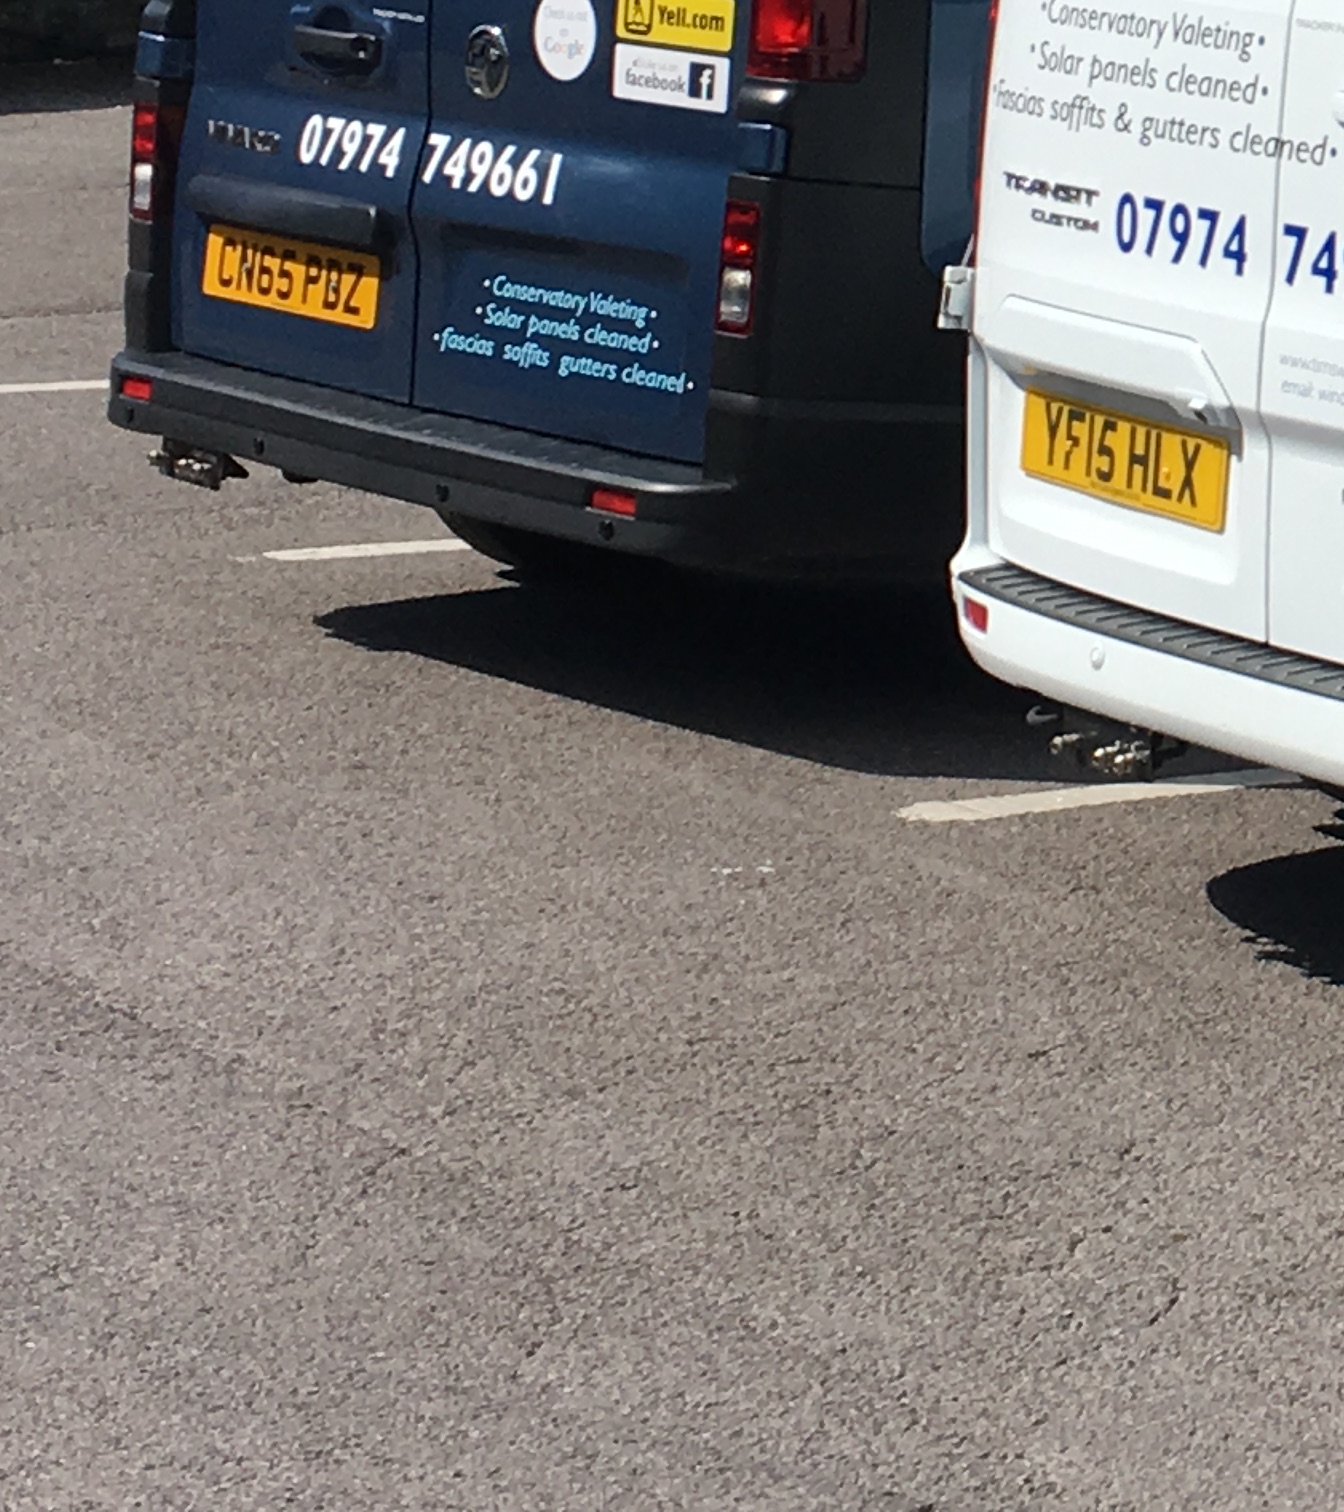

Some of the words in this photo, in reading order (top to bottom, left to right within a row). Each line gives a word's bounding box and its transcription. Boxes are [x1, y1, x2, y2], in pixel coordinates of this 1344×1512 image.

[656, 4, 726, 33] Yell.com
[1172, 12, 1256, 63] Valeting
[625, 68, 686, 93] facebook
[1037, 40, 1084, 77] Solar
[1088, 53, 1158, 90] panels
[1165, 63, 1260, 105] cleaned
[1051, 93, 1107, 133] soffits
[1113, 102, 1133, 134] &
[1139, 115, 1221, 149] gutters
[1229, 123, 1329, 166] cleaned
[298, 114, 406, 178] 07974
[421, 132, 564, 205] 749661
[1003, 171, 1101, 207] TRANSIT
[1031, 208, 1100, 233] CUSTOM
[1116, 192, 1248, 277] 07974
[216, 238, 294, 300] CN65
[484, 303, 525, 329] Solar
[526, 314, 581, 340] panels
[584, 323, 652, 353] cleaned
[492, 275, 588, 316] Conservatory
[589, 292, 649, 328] Valeting
[502, 341, 550, 368] soffits
[558, 354, 617, 380] gutters
[621, 362, 687, 394] cleaned
[1045, 400, 1118, 483] YF15
[1126, 424, 1202, 508] HLX
